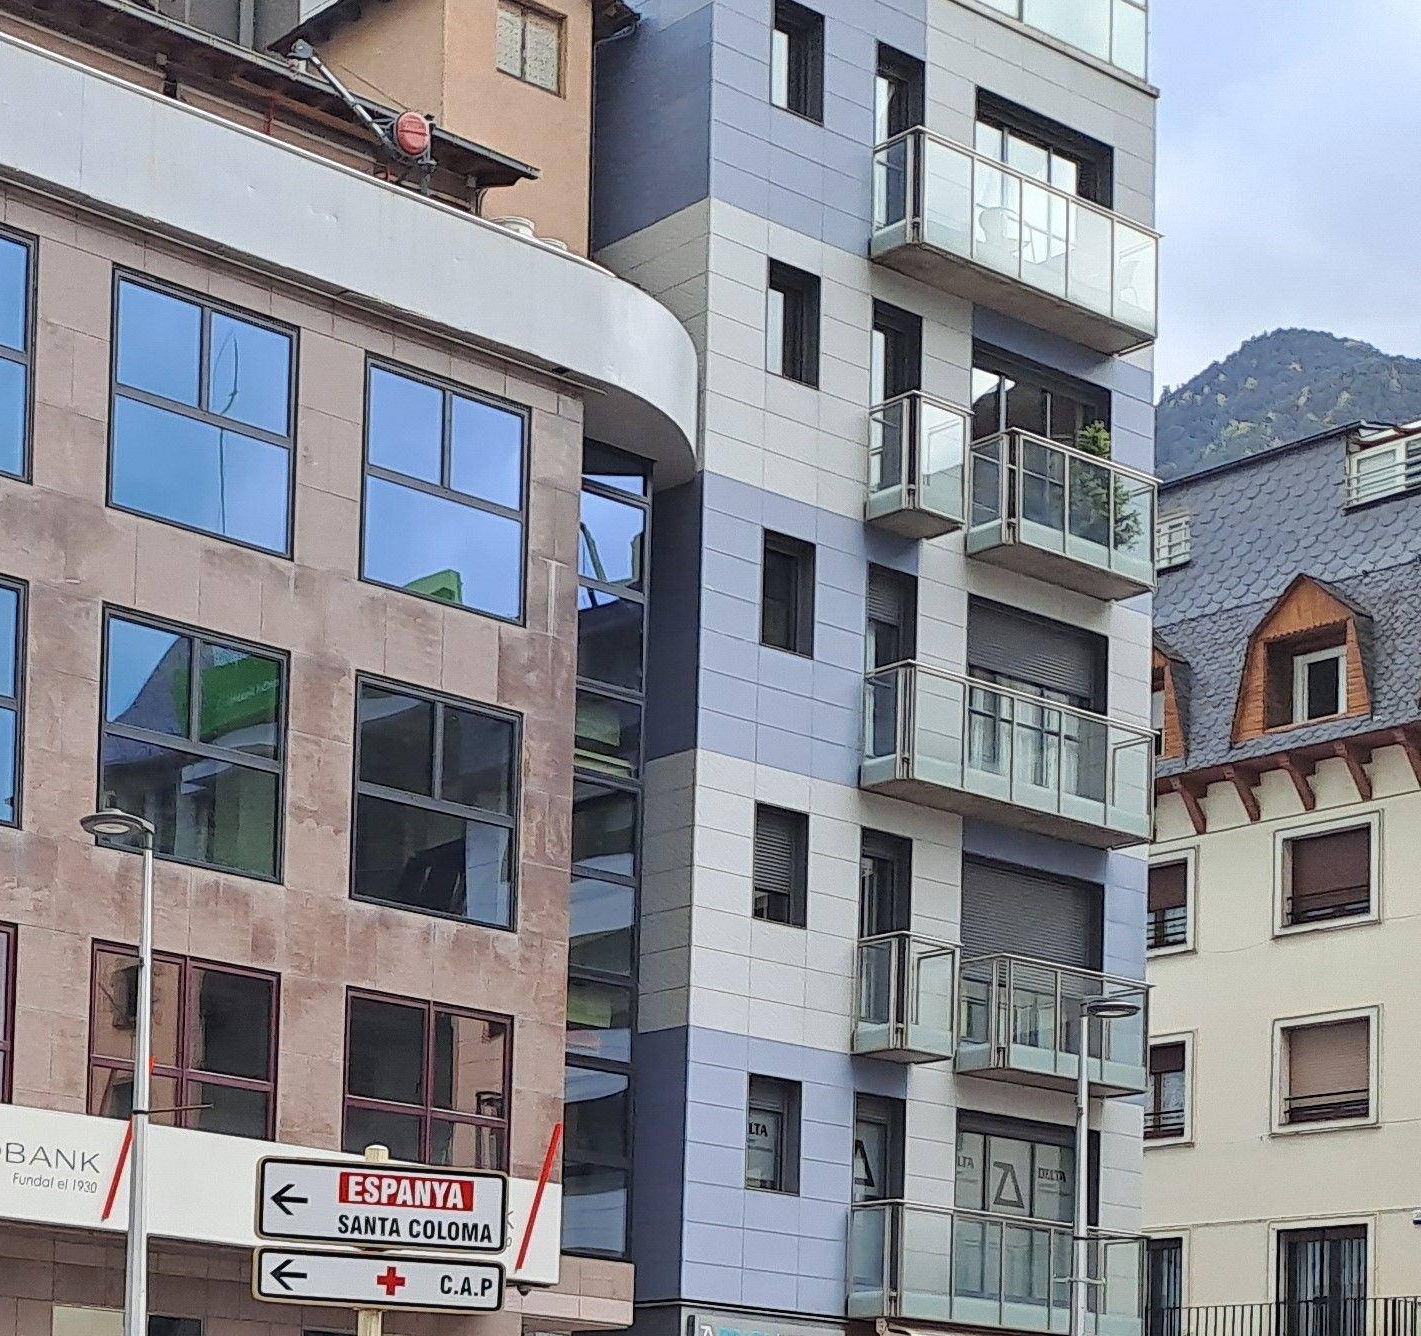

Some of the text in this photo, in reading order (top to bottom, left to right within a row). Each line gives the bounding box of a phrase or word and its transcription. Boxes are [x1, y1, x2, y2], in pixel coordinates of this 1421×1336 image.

[748, 1122, 768, 1137] LTA
[57, 1178, 69, 1191] el
[72, 1178, 98, 1194] 1930
[347, 1175, 464, 1210] ESPANYA
[338, 1214, 401, 1238] SANTA
[408, 1218, 493, 1244] COLOMA
[440, 1274, 493, 1297] C.A.P
